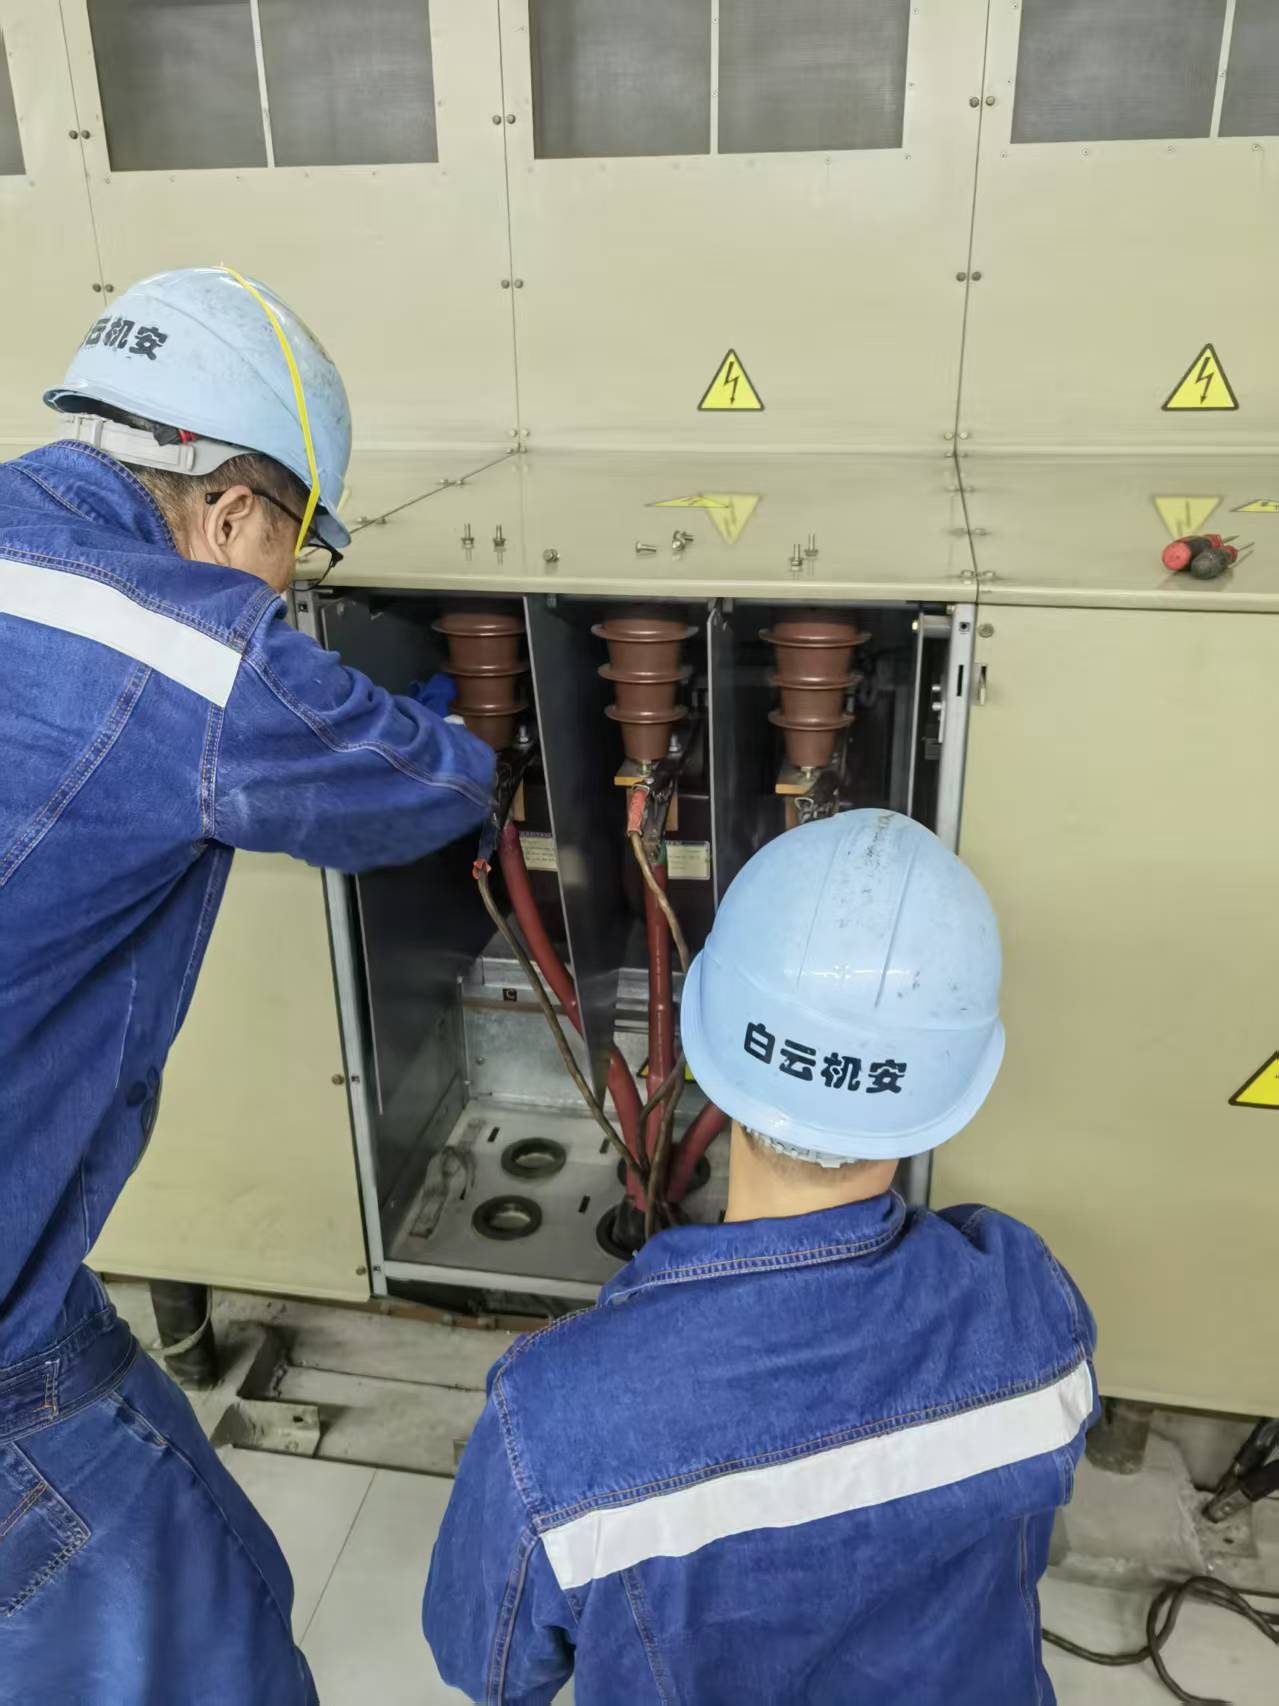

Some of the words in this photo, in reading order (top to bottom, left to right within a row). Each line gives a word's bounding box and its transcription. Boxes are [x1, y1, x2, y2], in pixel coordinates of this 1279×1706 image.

[80, 316, 168, 360] 云机安
[743, 1021, 907, 1094] 白云机安
